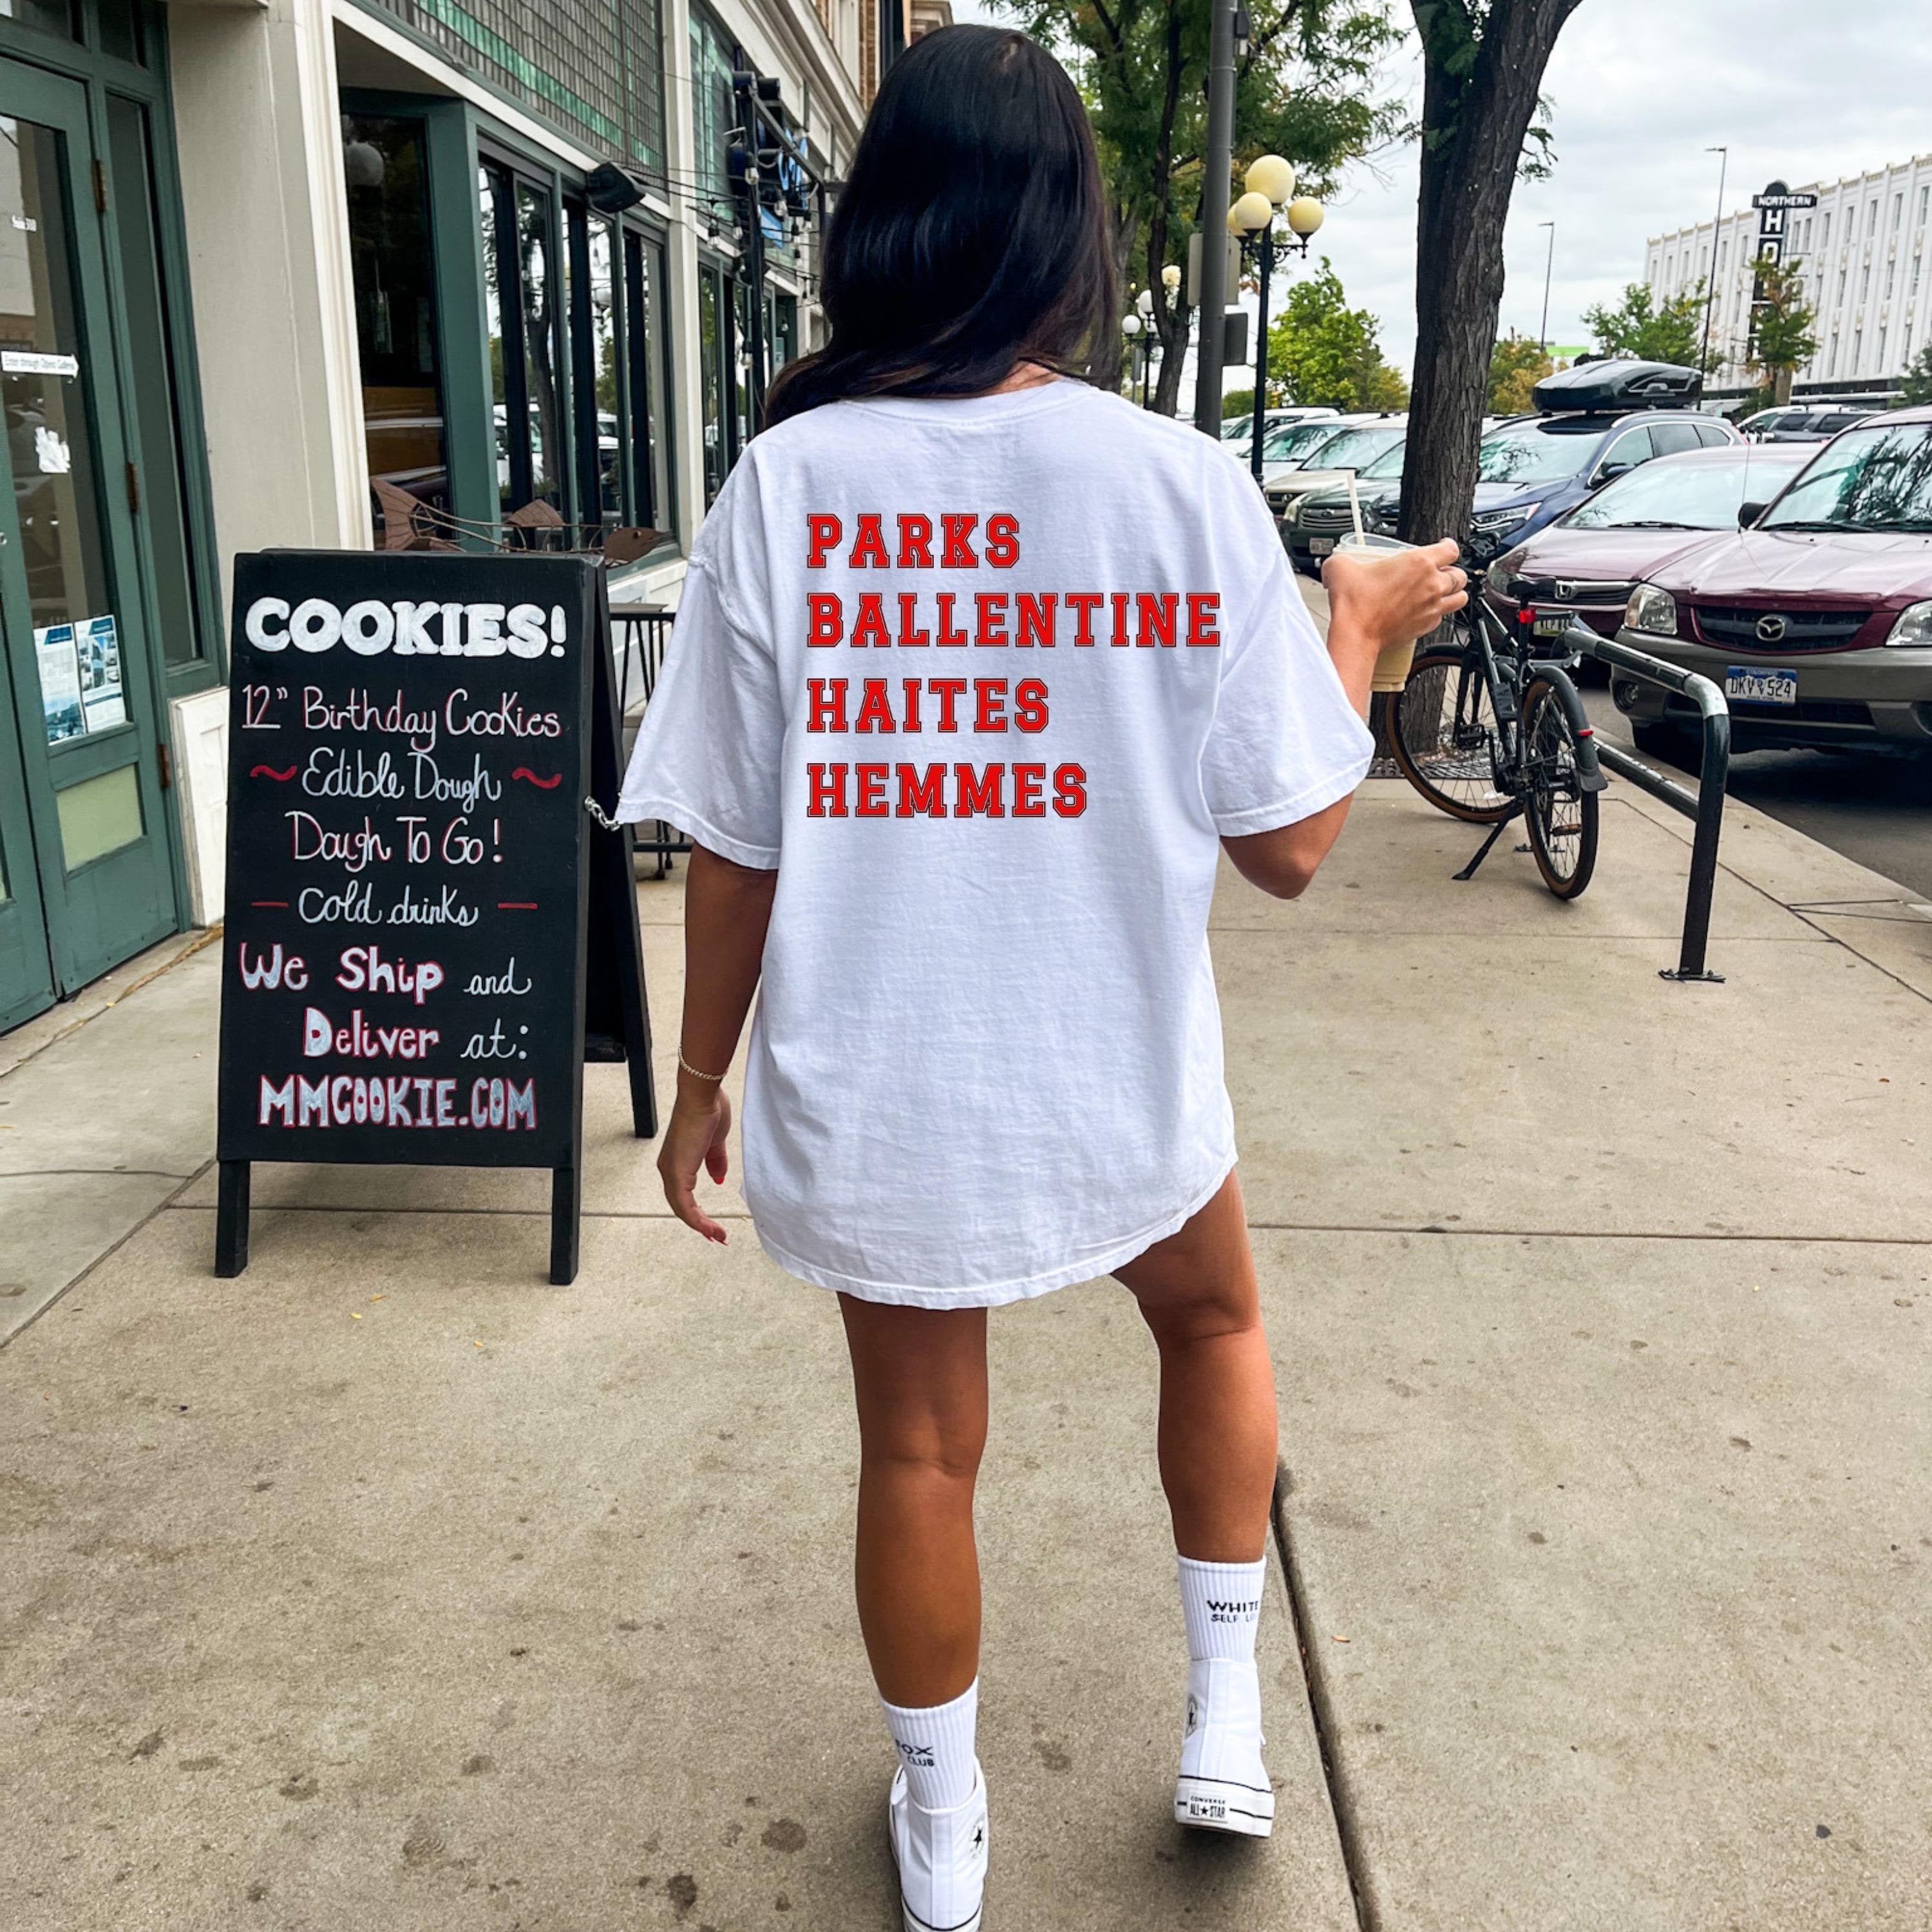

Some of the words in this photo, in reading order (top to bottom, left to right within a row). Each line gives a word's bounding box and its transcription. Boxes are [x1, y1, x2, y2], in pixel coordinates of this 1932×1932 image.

[1758, 196, 1812, 207] NORTHERN
[806, 514, 1019, 568] PARKS
[245, 596, 567, 659] COOKIES!
[806, 592, 1220, 647] BALLENTINE
[806, 678, 1049, 733] HAITES
[1766, 679, 1790, 697] 524
[303, 685, 437, 752] Birthday
[301, 747, 404, 799] Edible
[408, 751, 502, 813] Dough
[806, 762, 1087, 818] HEMMES
[285, 810, 391, 872] Dough
[395, 816, 431, 864] To
[298, 880, 382, 924] Cold
[240, 942, 308, 990] We
[335, 945, 444, 1005] Ship
[463, 956, 533, 996] and
[303, 1007, 440, 1059] Deliver
[460, 1018, 529, 1059] at:
[259, 1074, 537, 1131] MMCOOKIE.COM
[1211, 1613, 1237, 1623] SELF
[907, 1756, 934, 1766] CLUB
